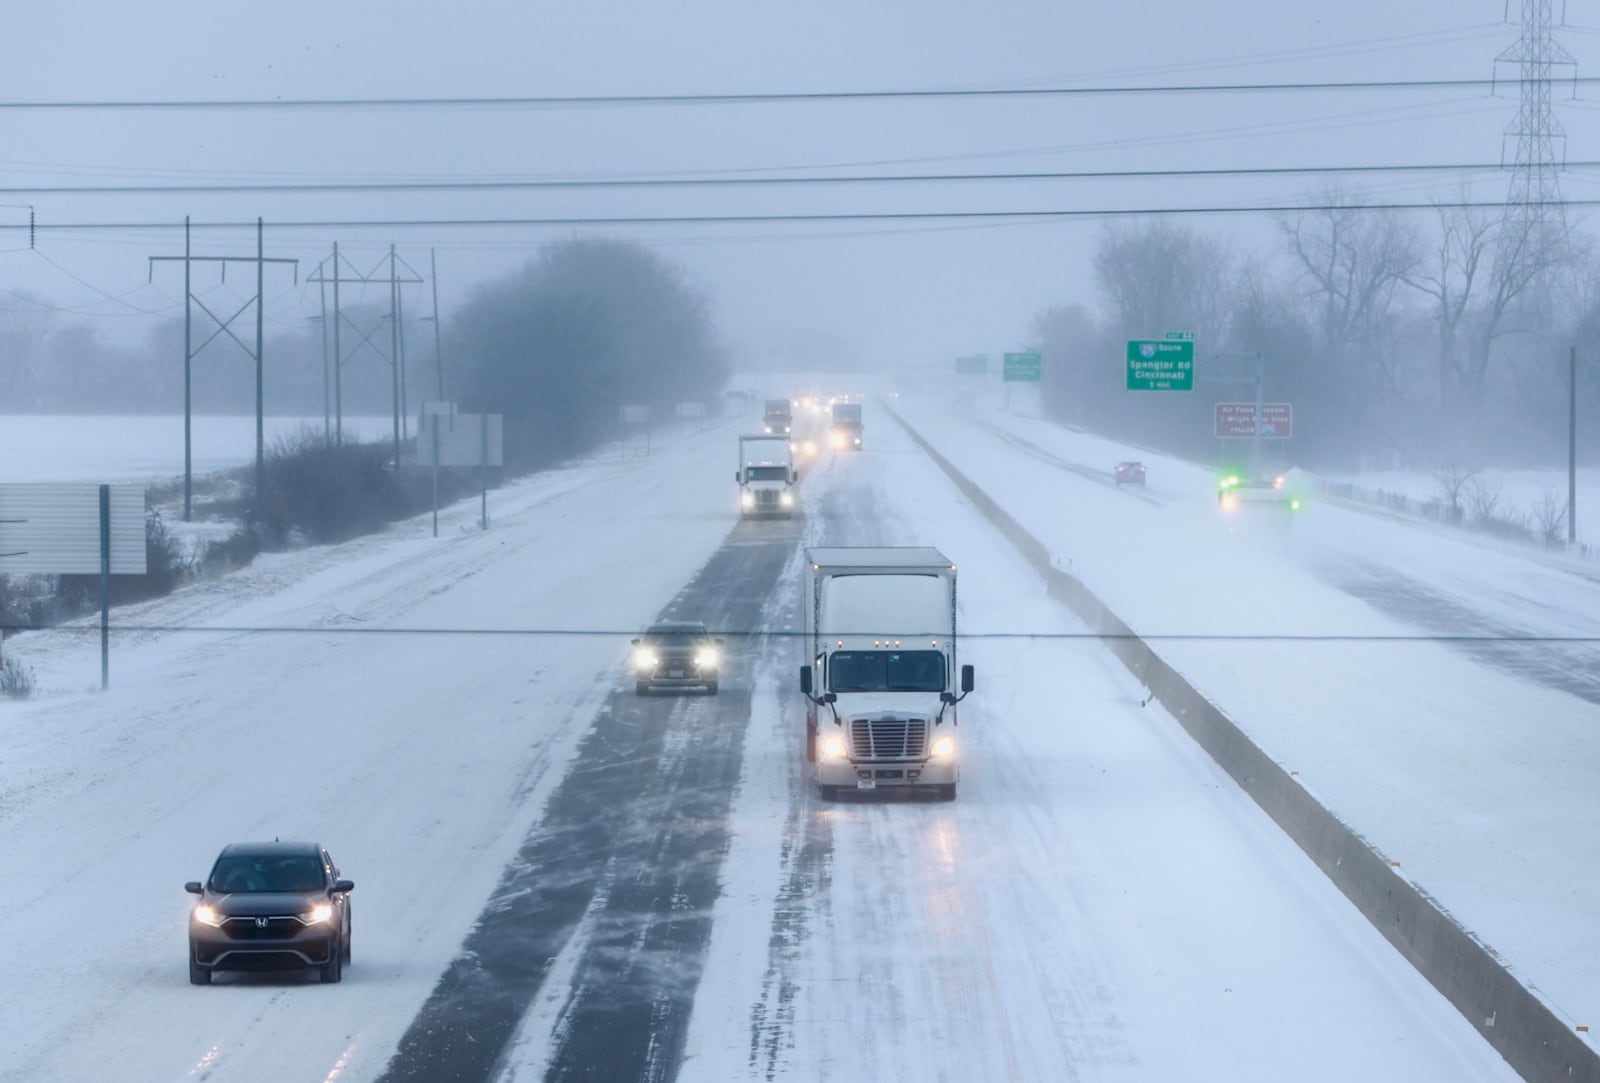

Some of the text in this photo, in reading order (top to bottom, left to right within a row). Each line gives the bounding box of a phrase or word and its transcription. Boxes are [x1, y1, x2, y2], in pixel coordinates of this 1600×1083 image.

[1130, 361, 1190, 370] Spangler Rd
[1135, 371, 1185, 379] Cincinnati
